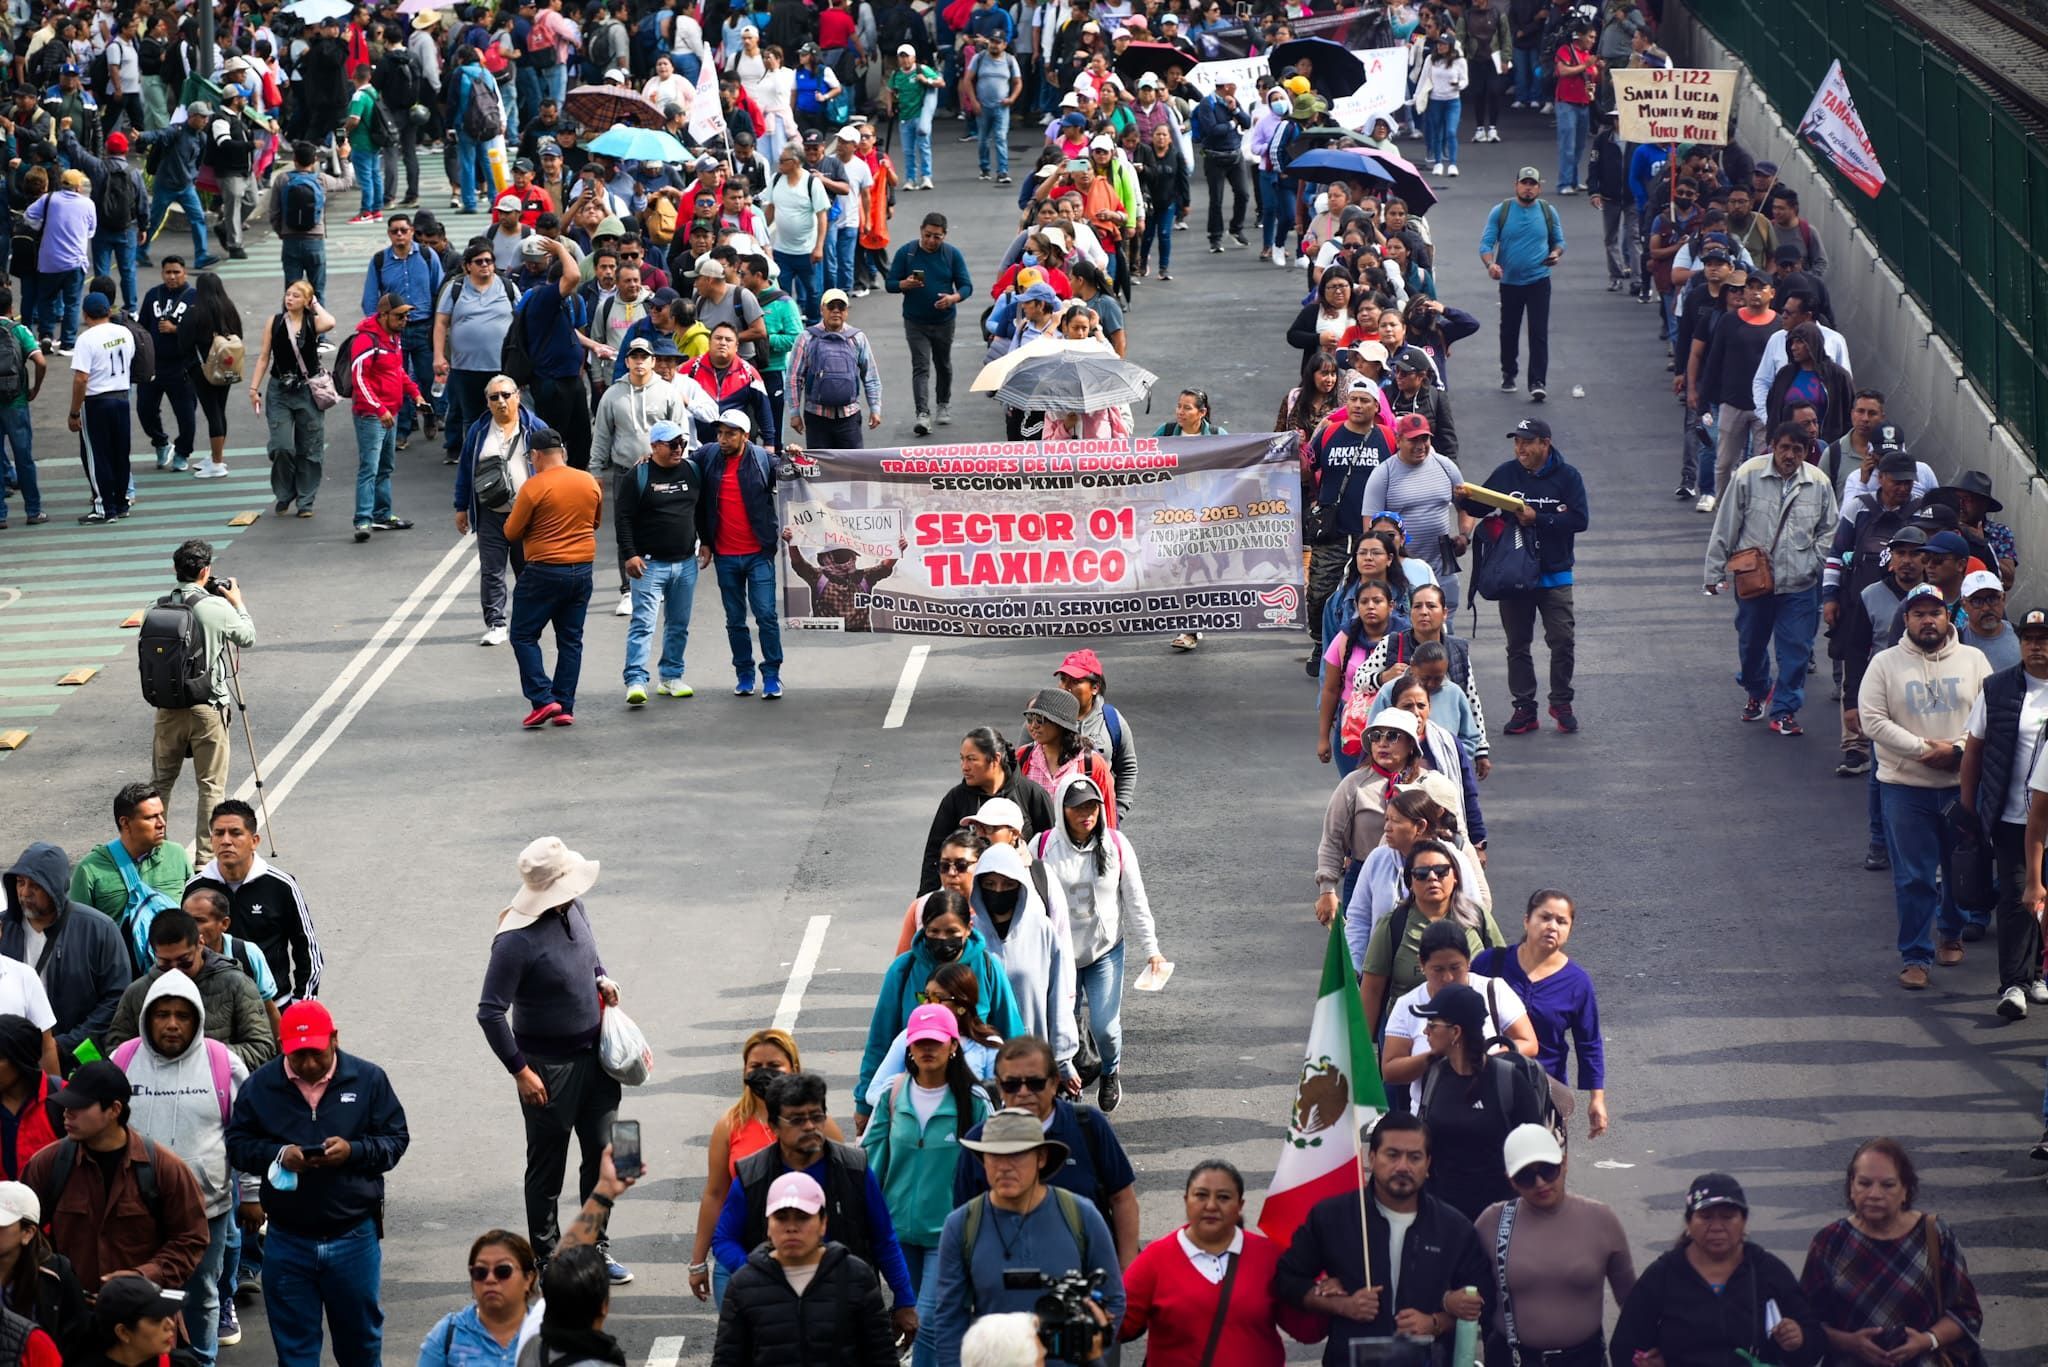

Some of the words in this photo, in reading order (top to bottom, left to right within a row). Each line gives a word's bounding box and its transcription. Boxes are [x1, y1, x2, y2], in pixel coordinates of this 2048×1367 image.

[1675, 84, 1719, 102] LUCIA
[110, 349, 125, 377] 11
[901, 443, 1038, 458] COORDINADORA
[1043, 440, 1130, 455] NACIONAL
[1136, 438, 1160, 454] DE
[881, 459, 1019, 474] TRABAJADORES
[1024, 458, 1046, 473] DE
[1051, 458, 1073, 472] LA
[1078, 452, 1178, 471] EDUCACIÓN
[1328, 457, 1380, 466] TLAIACO
[931, 474, 1022, 491] SECCIÓN
[1029, 476, 1074, 490] XXII
[1081, 471, 1172, 488] OAXACA
[793, 510, 813, 525] NO
[914, 511, 1075, 547] SECTOR
[1089, 507, 1135, 541] 01
[1179, 519, 1296, 542] PERDONAMOS!
[1187, 534, 1289, 555] OLVIDAMOS!
[923, 548, 1127, 587] TLAXIACO
[855, 593, 895, 611] ¡POR
[899, 598, 921, 613] LA
[926, 598, 1027, 619] EDUCACIÓN
[1032, 600, 1054, 617] AL
[1059, 598, 1142, 617] SERVICIO
[1147, 595, 1180, 612] DEL
[1185, 590, 1257, 608] PUEBLO!
[893, 616, 965, 633] ¡UNIDOS
[968, 622, 981, 634] Y
[986, 620, 1113, 637] ORGANIZADOS
[1118, 613, 1242, 632] VENCEREMOS!
[1905, 677, 1961, 715] CAT
